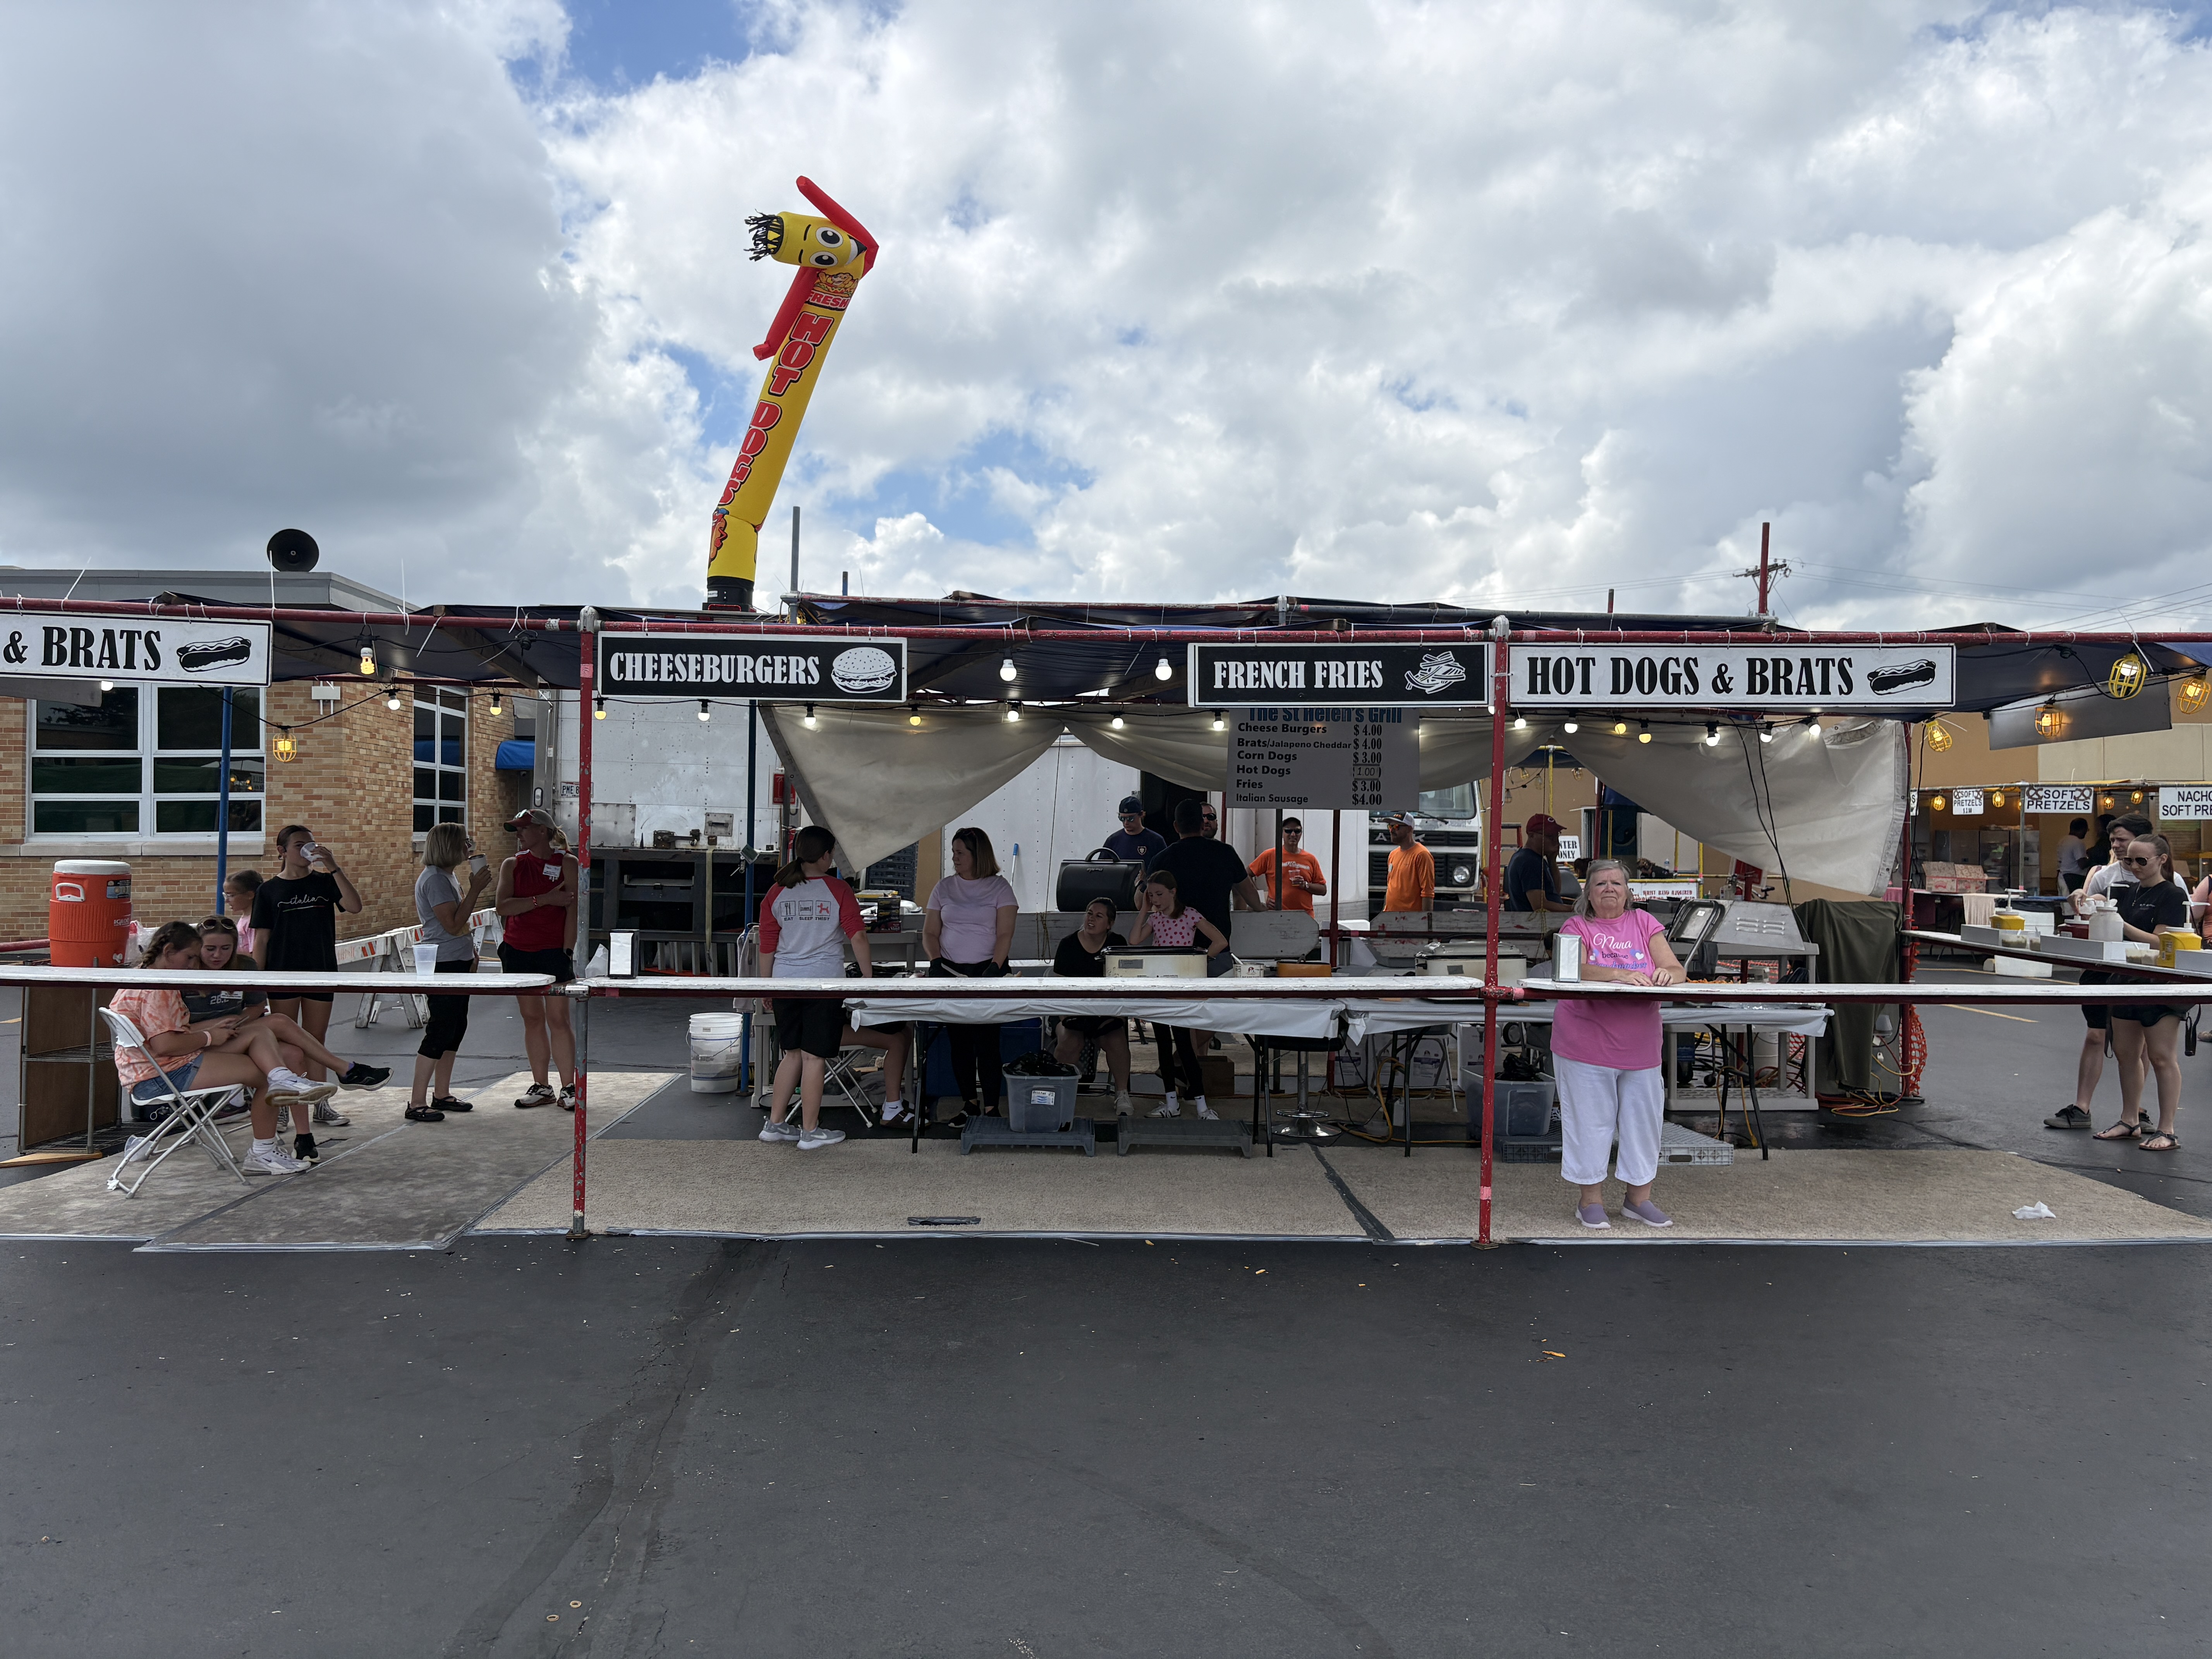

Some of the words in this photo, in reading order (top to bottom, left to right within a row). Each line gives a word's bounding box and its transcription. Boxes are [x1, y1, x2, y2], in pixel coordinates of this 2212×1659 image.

[769, 311, 834, 397] HOT
[3, 631, 28, 664] &
[41, 626, 161, 671] BRATS
[610, 652, 820, 685] CHEESEBURGERS
[1214, 661, 1305, 689] FRENCH
[1314, 660, 1383, 689] FRIES
[1527, 657, 1596, 695] HOT
[1610, 657, 1700, 696] DOGS
[1711, 663, 1734, 694] &
[1746, 657, 1854, 696] BRATS
[1250, 708, 1278, 721] The
[1283, 708, 1299, 721] St
[1369, 708, 1401, 723] Grill
[1238, 723, 1278, 732] Cheese
[1282, 724, 1327, 735] Burgers
[1237, 750, 1264, 760] Corn
[1268, 751, 1297, 763] Dogs
[1237, 765, 1258, 774] Hot
[1262, 766, 1291, 777] Dogs
[1357, 767, 1375, 776] 1.00
[1236, 779, 1263, 788] Fries
[1236, 793, 1265, 802] Italian
[1269, 794, 1308, 805] Sausage
[1352, 793, 1382, 805] $4.00
[2044, 790, 2076, 799] SOFT
[2027, 800, 2090, 810] PRETZELS
[2162, 805, 2191, 816] SOFT
[1558, 850, 1575, 859] ONLY
[1593, 933, 1633, 949] Nana
